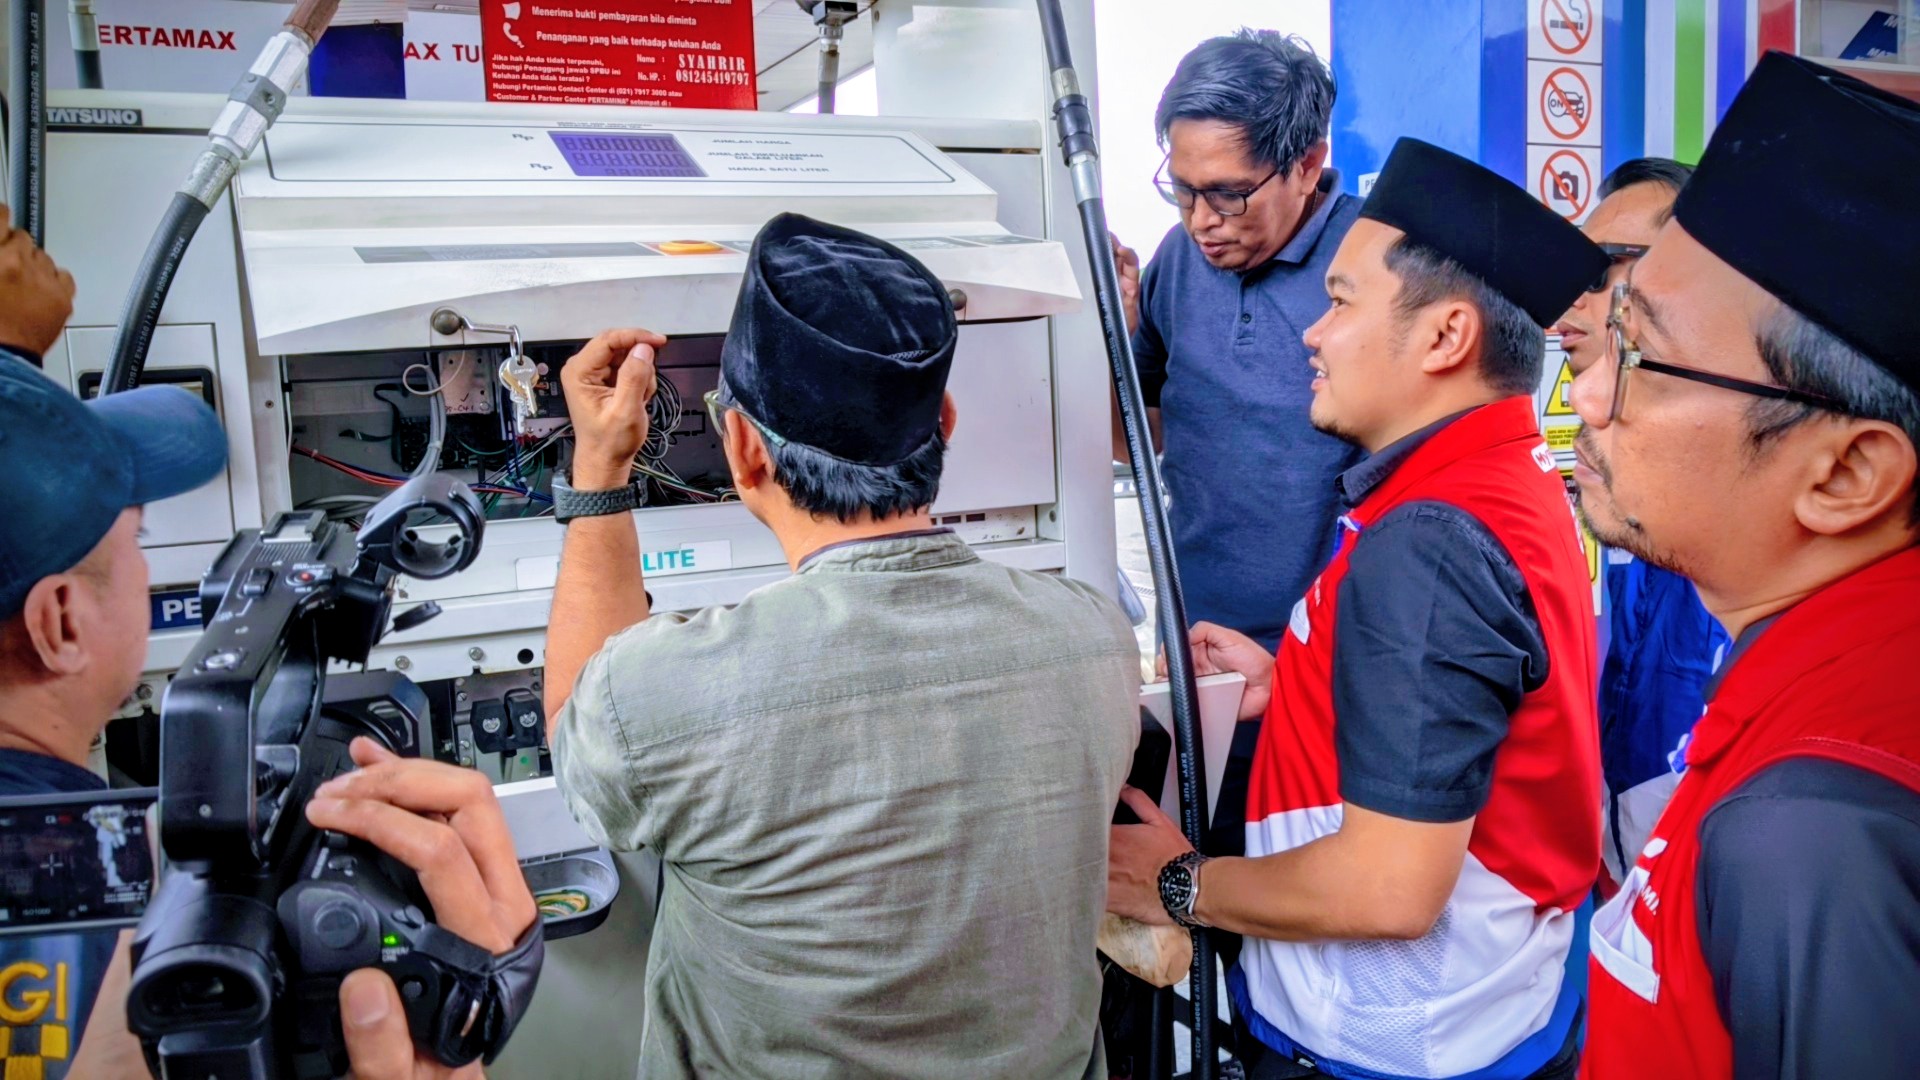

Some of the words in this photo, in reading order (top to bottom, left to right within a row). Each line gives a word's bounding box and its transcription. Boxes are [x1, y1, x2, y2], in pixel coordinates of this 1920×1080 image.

[532, 5, 573, 18] Menerima
[575, 9, 596, 19] bukti
[598, 11, 648, 24] pembayaran
[650, 14, 665, 24] bila
[667, 15, 697, 26] diminta
[98, 25, 237, 50] ERTAMAX
[536, 31, 588, 44] Penanganan
[589, 35, 609, 46] yang
[611, 35, 629, 45] baik
[631, 37, 667, 49] terhadap
[668, 39, 699, 49] keluhan
[701, 40, 721, 50] Anda
[30, 43, 38, 65] FUEL
[403, 42, 440, 60] AX
[452, 44, 480, 63] TU
[492, 54, 508, 62] Jika
[526, 55, 545, 63] Anda
[546, 56, 565, 64] tidak
[492, 63, 522, 72] hubungi
[566, 66, 588, 74] jawab
[679, 54, 745, 71] SYAHRIR
[540, 73, 557, 81] tidak
[559, 74, 584, 82] teratasi
[676, 69, 749, 86] 081245419797
[30, 71, 38, 125] DISPENSER
[493, 83, 520, 91] Hubungi
[522, 84, 556, 92] Pertamina
[558, 85, 584, 93] Contact
[585, 86, 607, 94] Center
[538, 94, 563, 102] Partner
[564, 95, 586, 103] Center
[1550, 98, 1563, 108] ON
[46, 108, 138, 125] TATSUNO
[30, 128, 38, 166] RUBBER
[642, 549, 695, 571] LITE
[162, 598, 201, 622] PE
[0, 961, 68, 1025] GI
